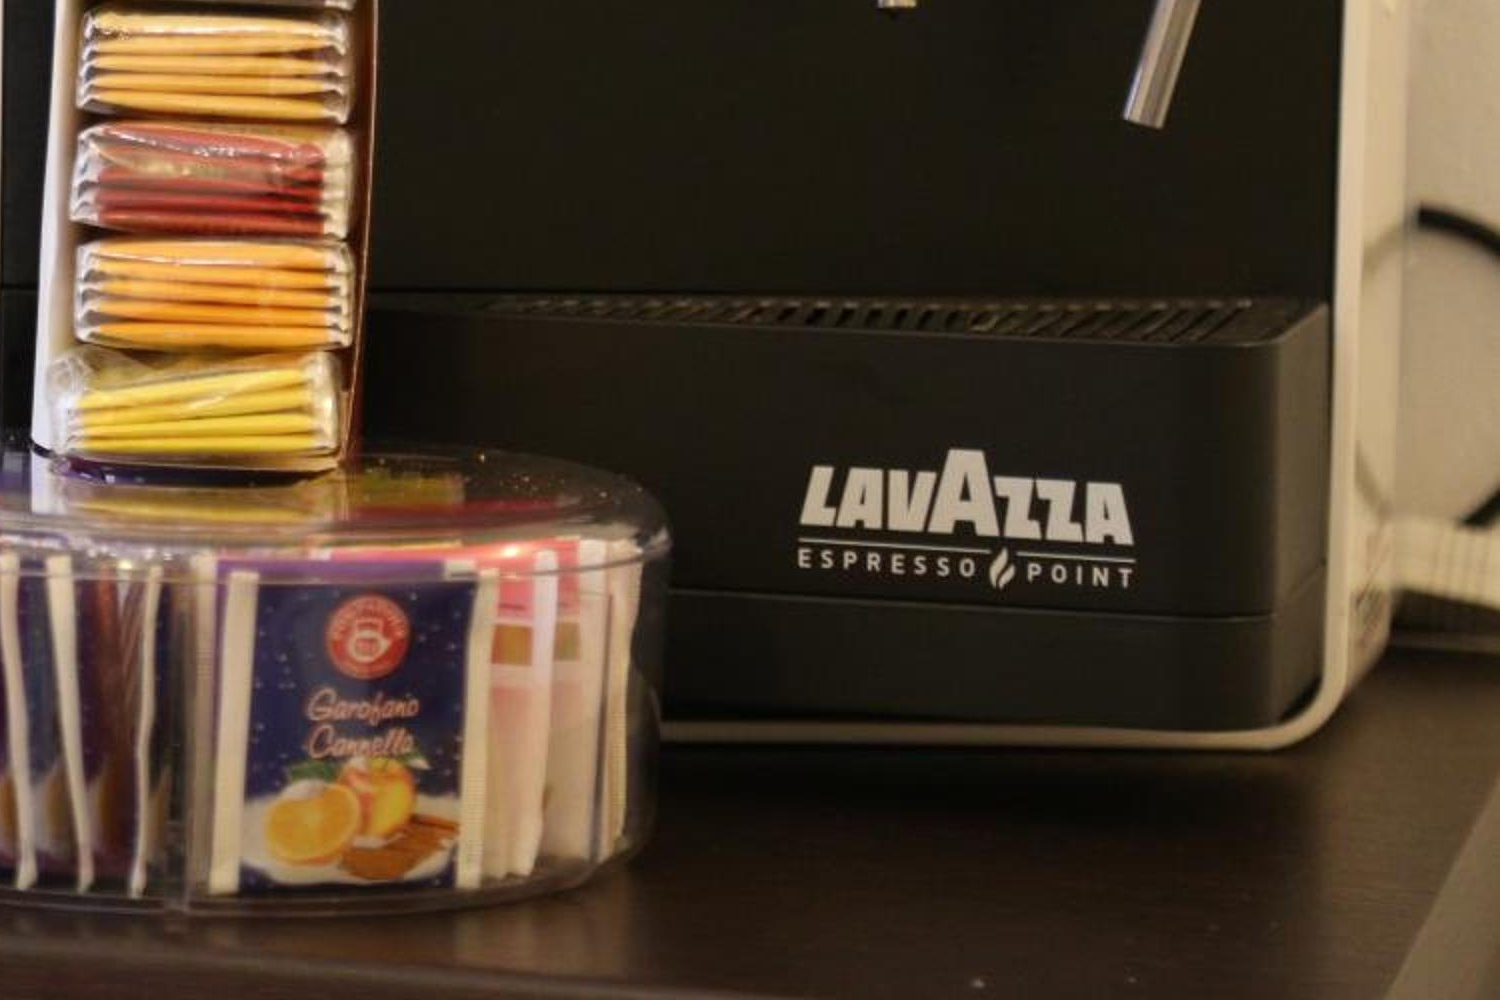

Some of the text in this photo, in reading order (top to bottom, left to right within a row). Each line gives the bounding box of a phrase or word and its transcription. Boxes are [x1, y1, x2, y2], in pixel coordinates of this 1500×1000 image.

[799, 448, 1135, 546] LAVAZZA
[797, 548, 1134, 588] ESPRESSO POINT
[307, 687, 420, 726] Garofano
